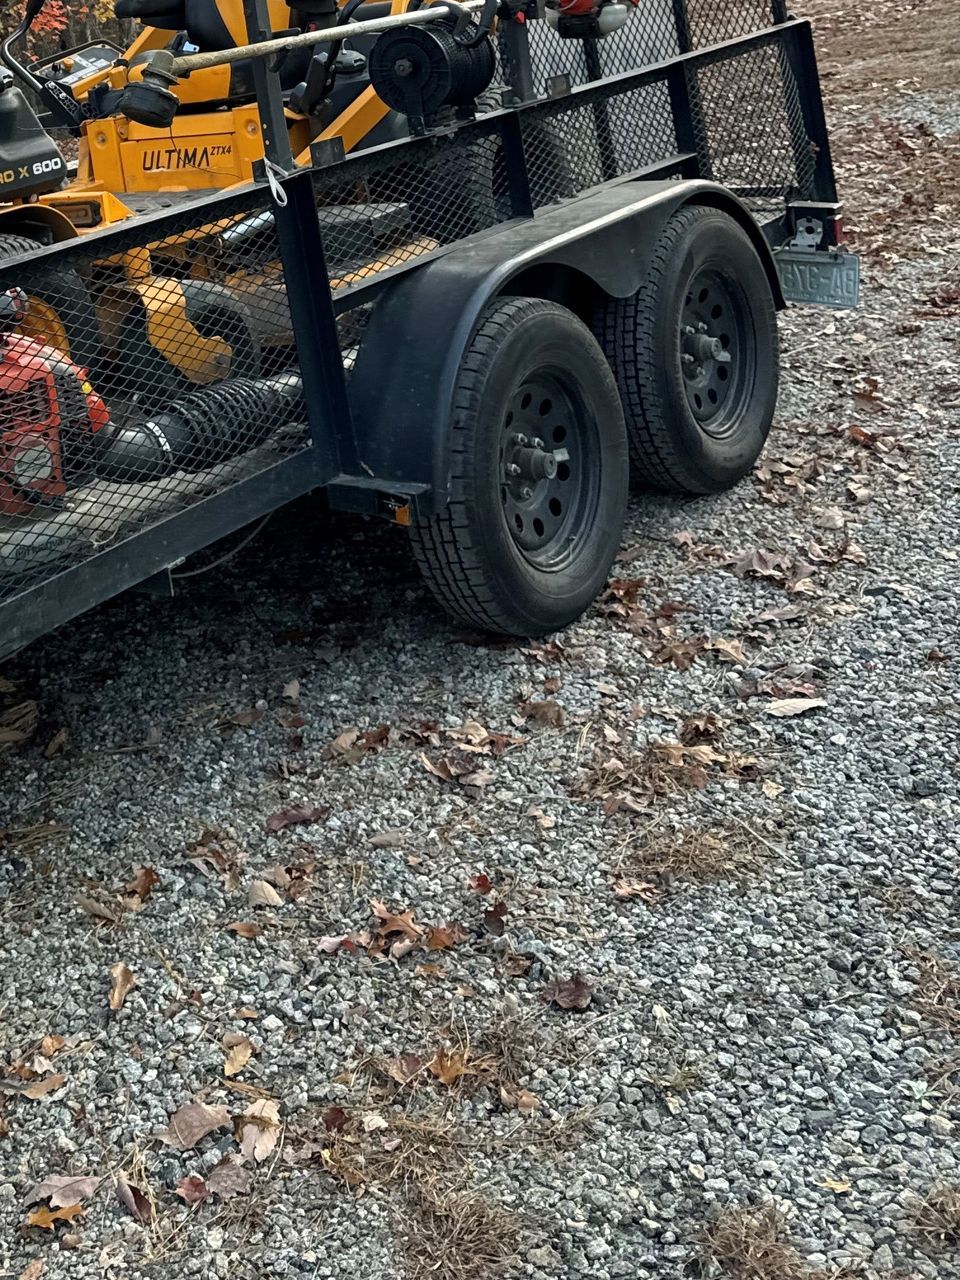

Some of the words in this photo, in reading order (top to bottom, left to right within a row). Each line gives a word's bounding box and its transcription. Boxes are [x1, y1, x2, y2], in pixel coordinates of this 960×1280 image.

[18, 166, 30, 179] X
[33, 157, 61, 175] 600
[142, 147, 210, 171] ULTIMA
[210, 145, 232, 156] ZTX4
